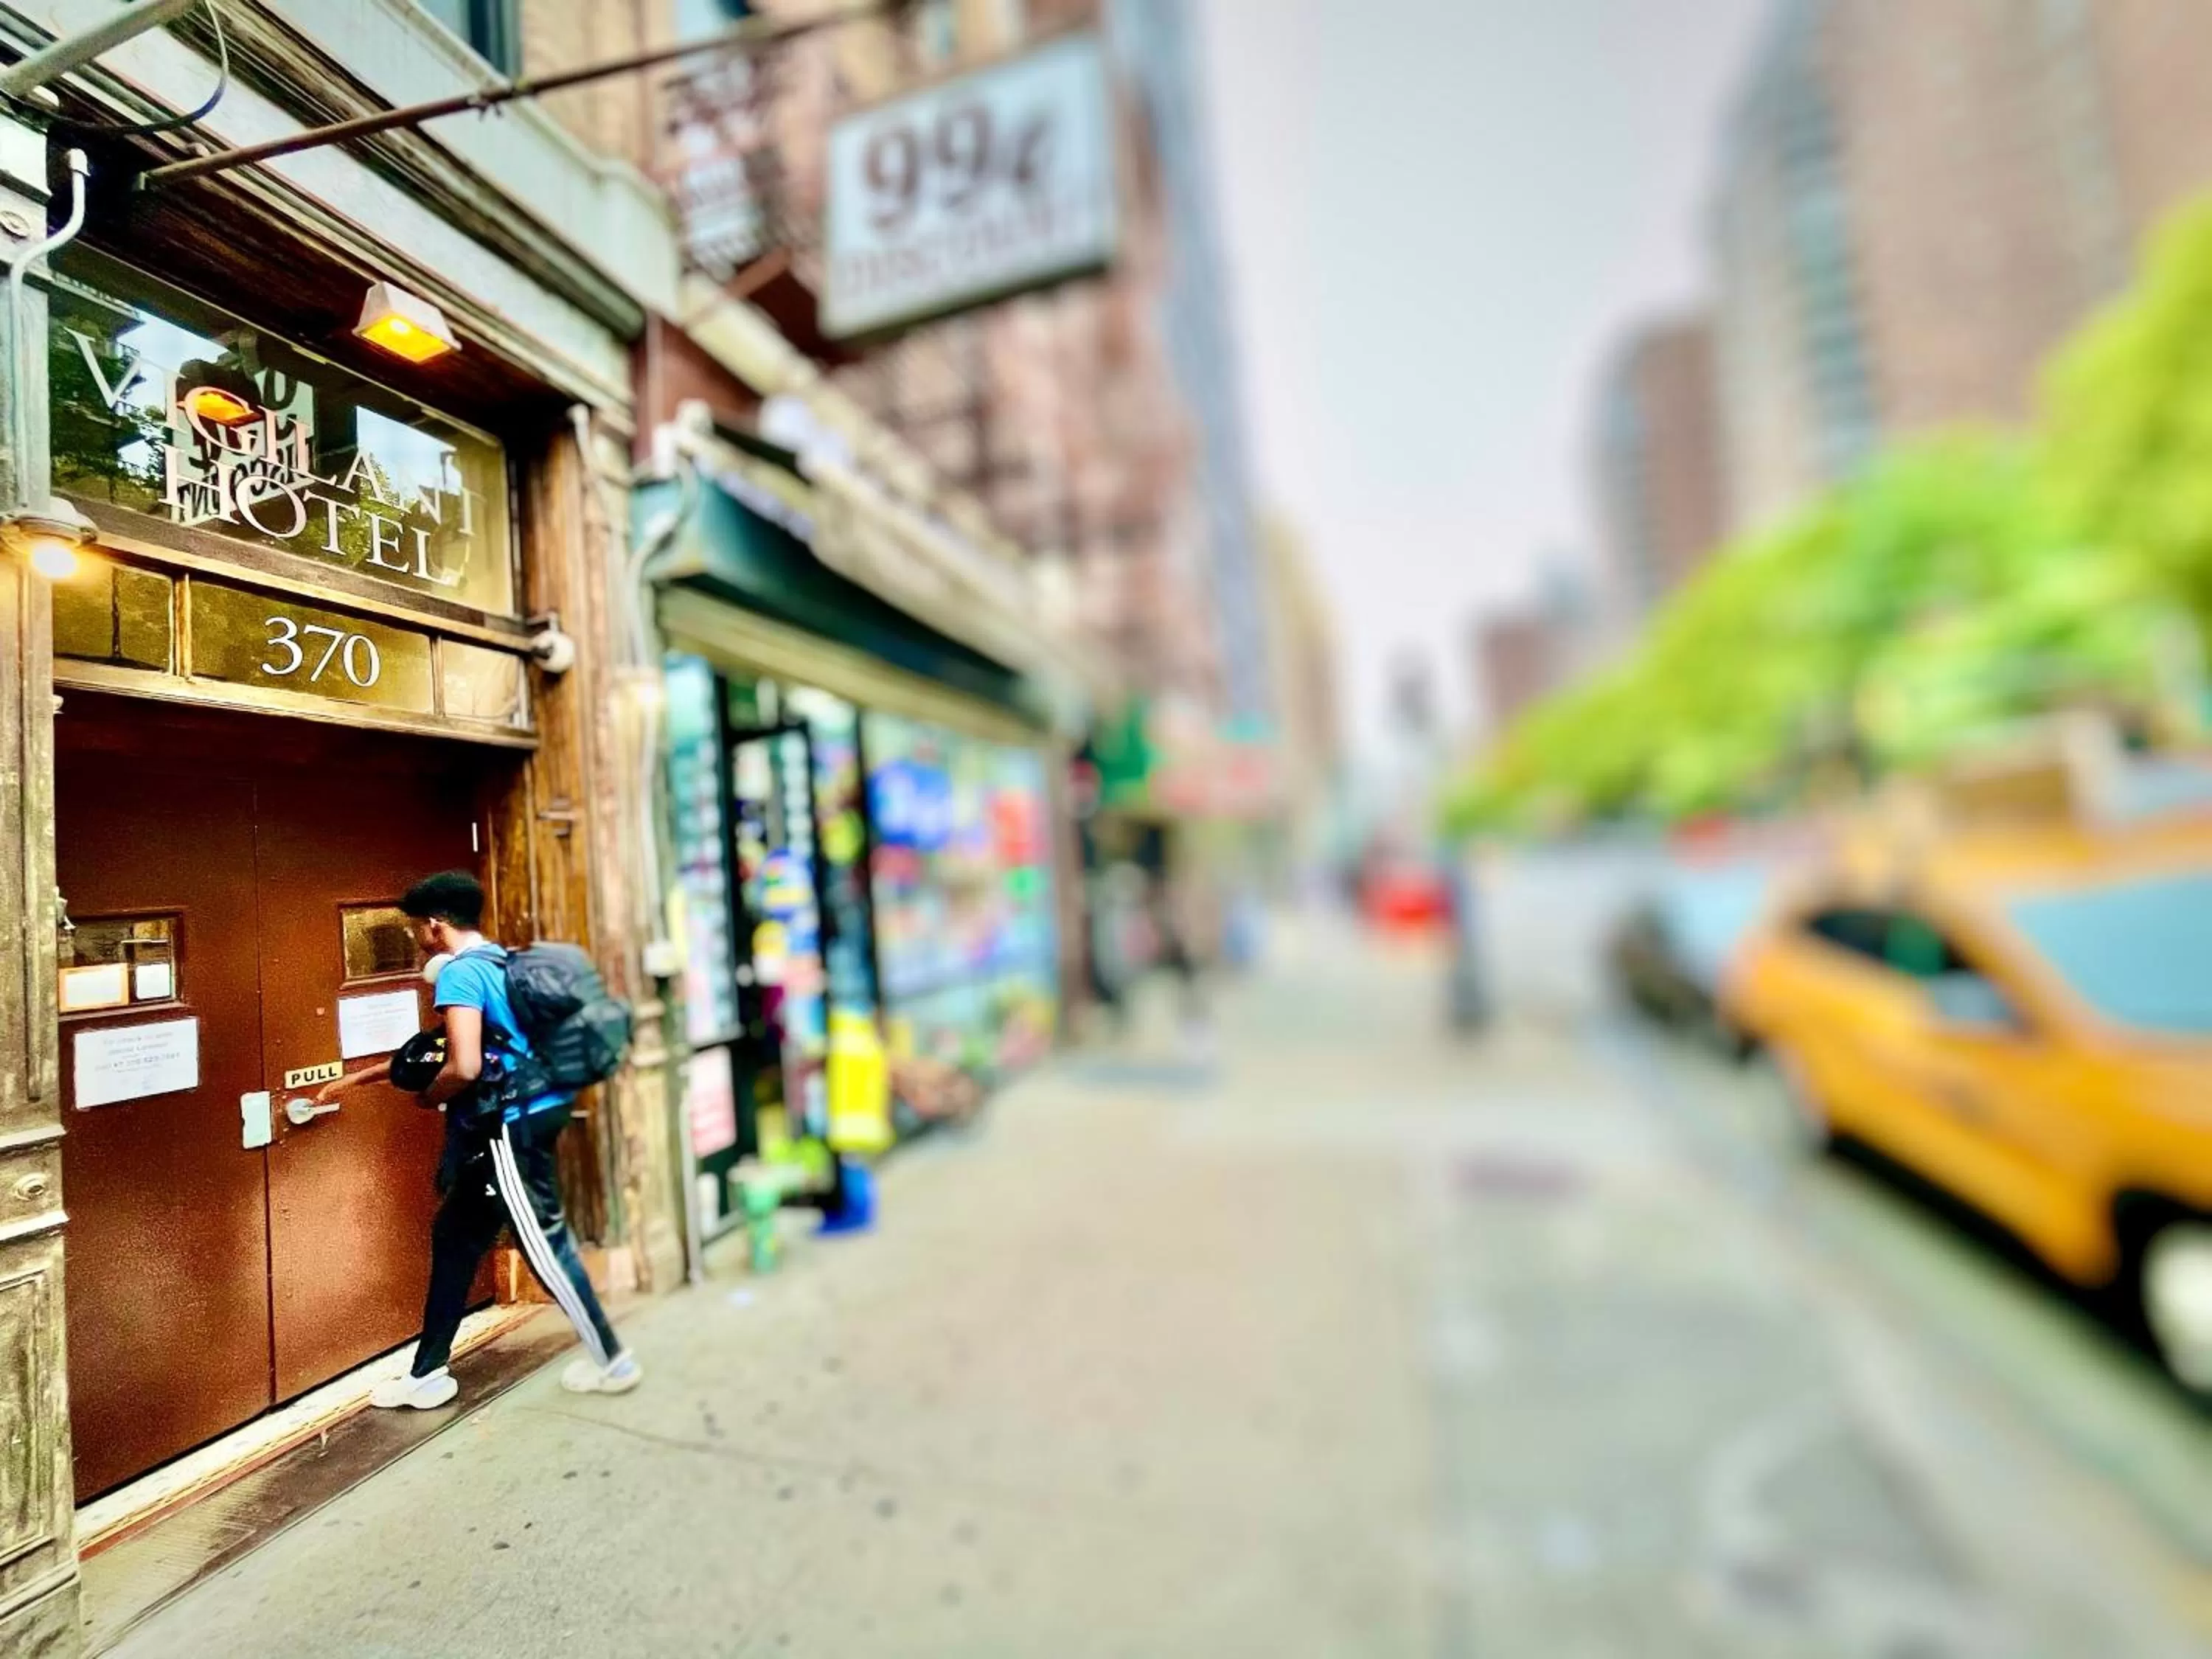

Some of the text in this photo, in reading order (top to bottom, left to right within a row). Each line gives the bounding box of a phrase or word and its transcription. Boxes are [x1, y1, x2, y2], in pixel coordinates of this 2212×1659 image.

[158, 442, 458, 587] HOTEL
[262, 617, 380, 687] 370
[291, 1066, 337, 1085] PULL
